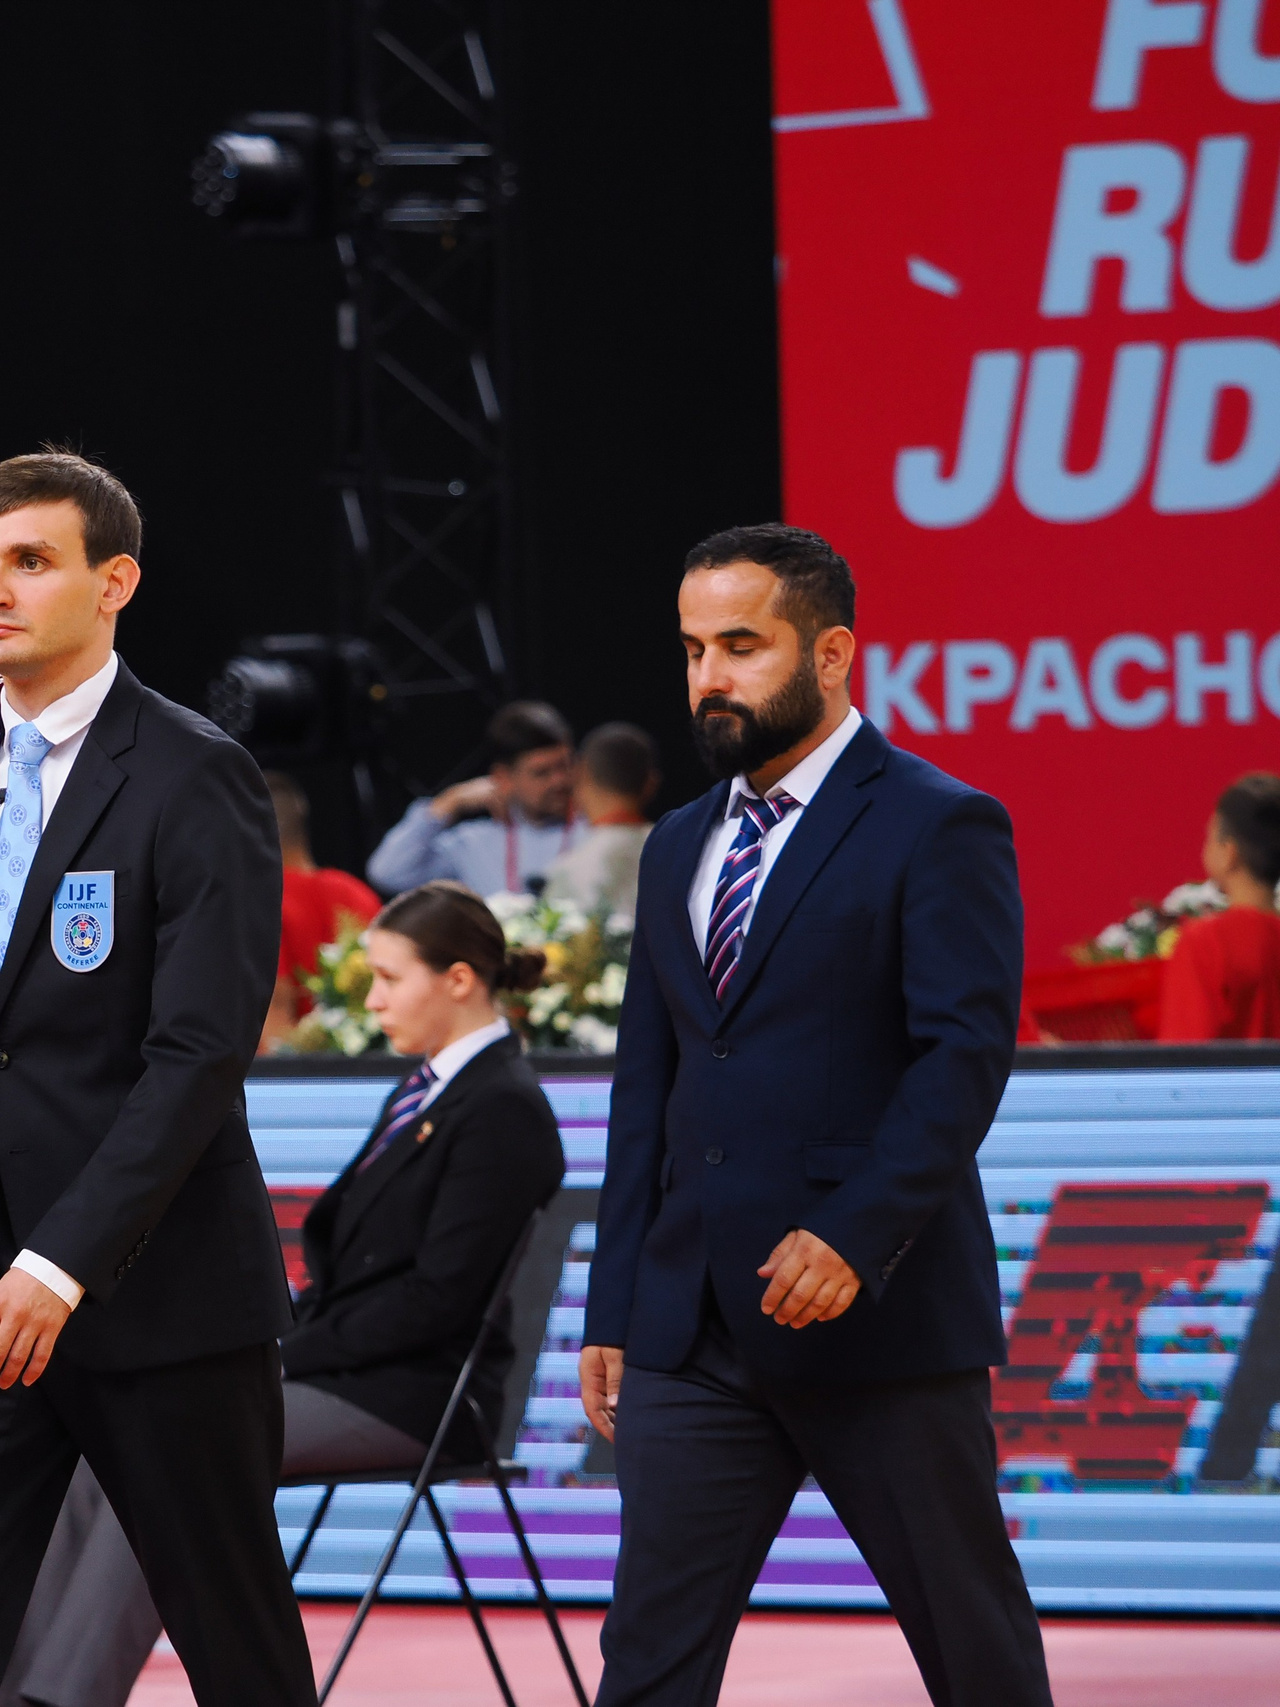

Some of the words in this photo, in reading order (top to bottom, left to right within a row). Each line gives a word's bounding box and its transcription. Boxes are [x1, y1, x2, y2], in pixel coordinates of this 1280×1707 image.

[863, 631, 1280, 735] КРАСН
[69, 883, 97, 901] IJF
[57, 902, 109, 910] CONTINENTAL
[66, 954, 99, 966] REFEREE
